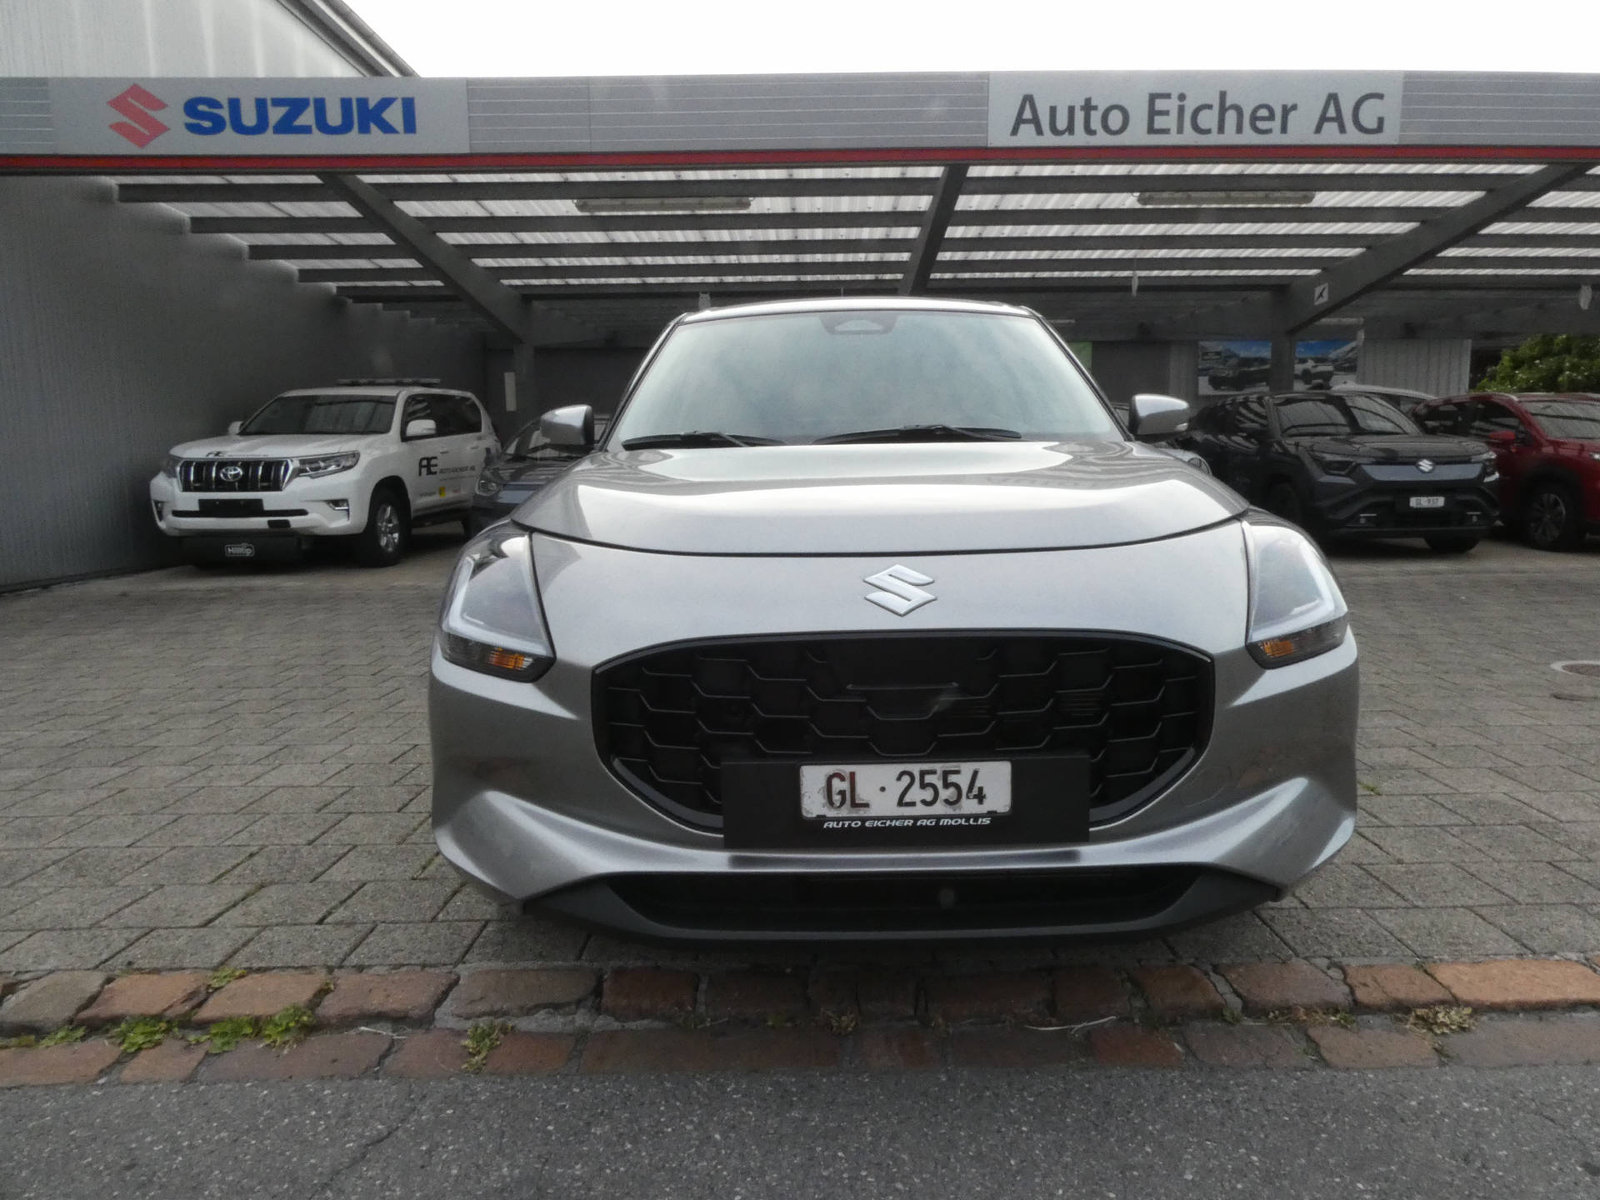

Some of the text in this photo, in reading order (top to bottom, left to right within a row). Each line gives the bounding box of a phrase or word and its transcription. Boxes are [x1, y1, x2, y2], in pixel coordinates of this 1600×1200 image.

[184, 97, 416, 135] SUZUKI
[1010, 90, 1386, 137] Auto Eicher AG
[826, 772, 870, 810] GL
[896, 768, 986, 808] 2554
[823, 817, 992, 829] AUTO EICHER AG MOLLIS
